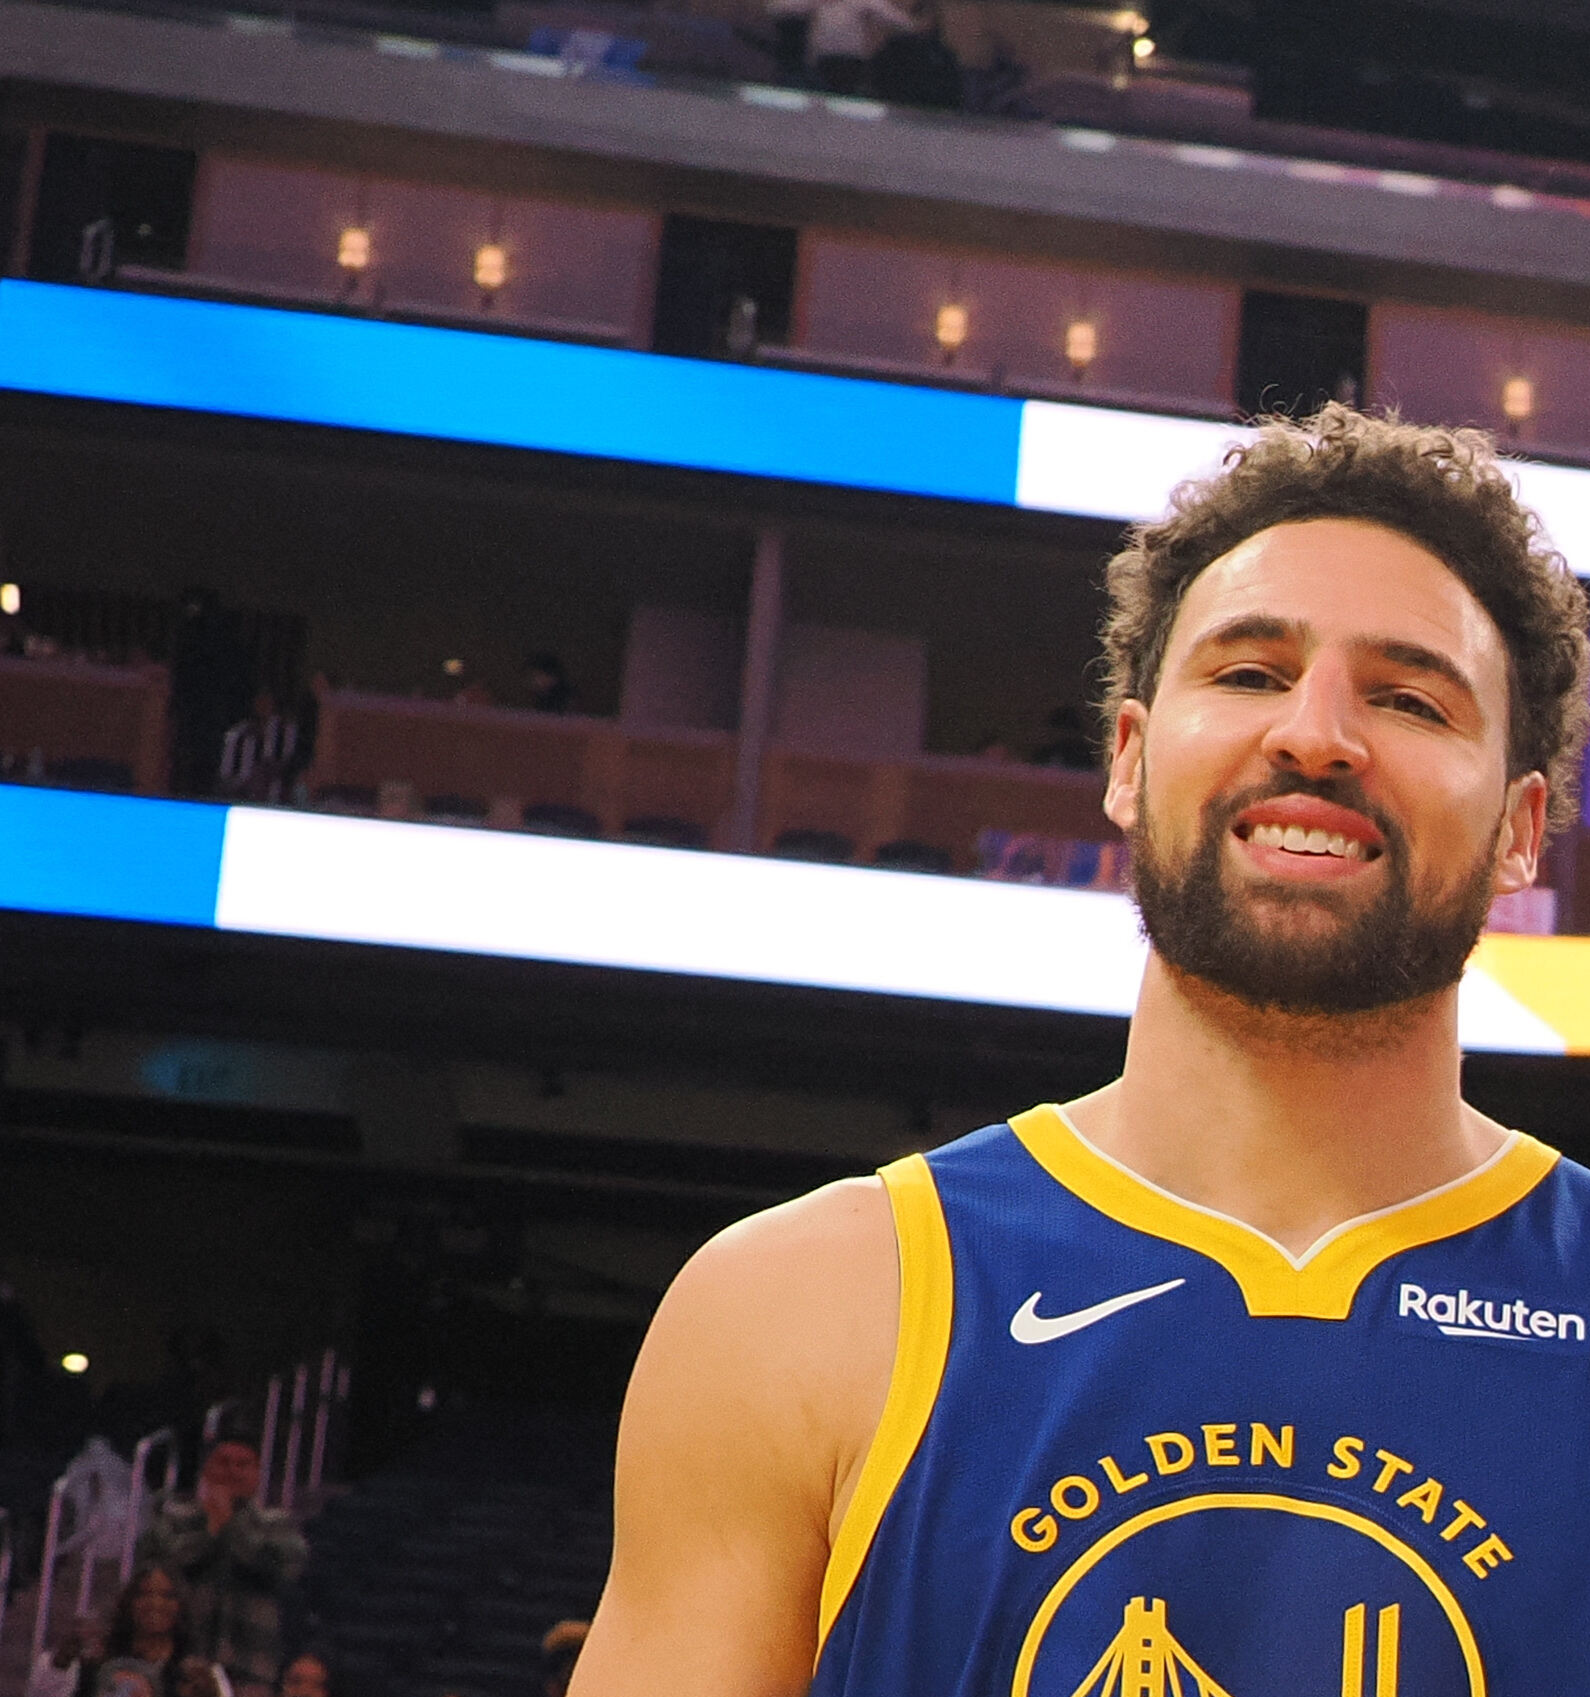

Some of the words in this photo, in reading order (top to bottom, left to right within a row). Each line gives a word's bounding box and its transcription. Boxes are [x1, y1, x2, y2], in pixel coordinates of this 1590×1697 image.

[1398, 1282, 1586, 1343] Rakuten
[1010, 1421, 1296, 1554] GOLDEN
[1326, 1435, 1514, 1580] STATE
